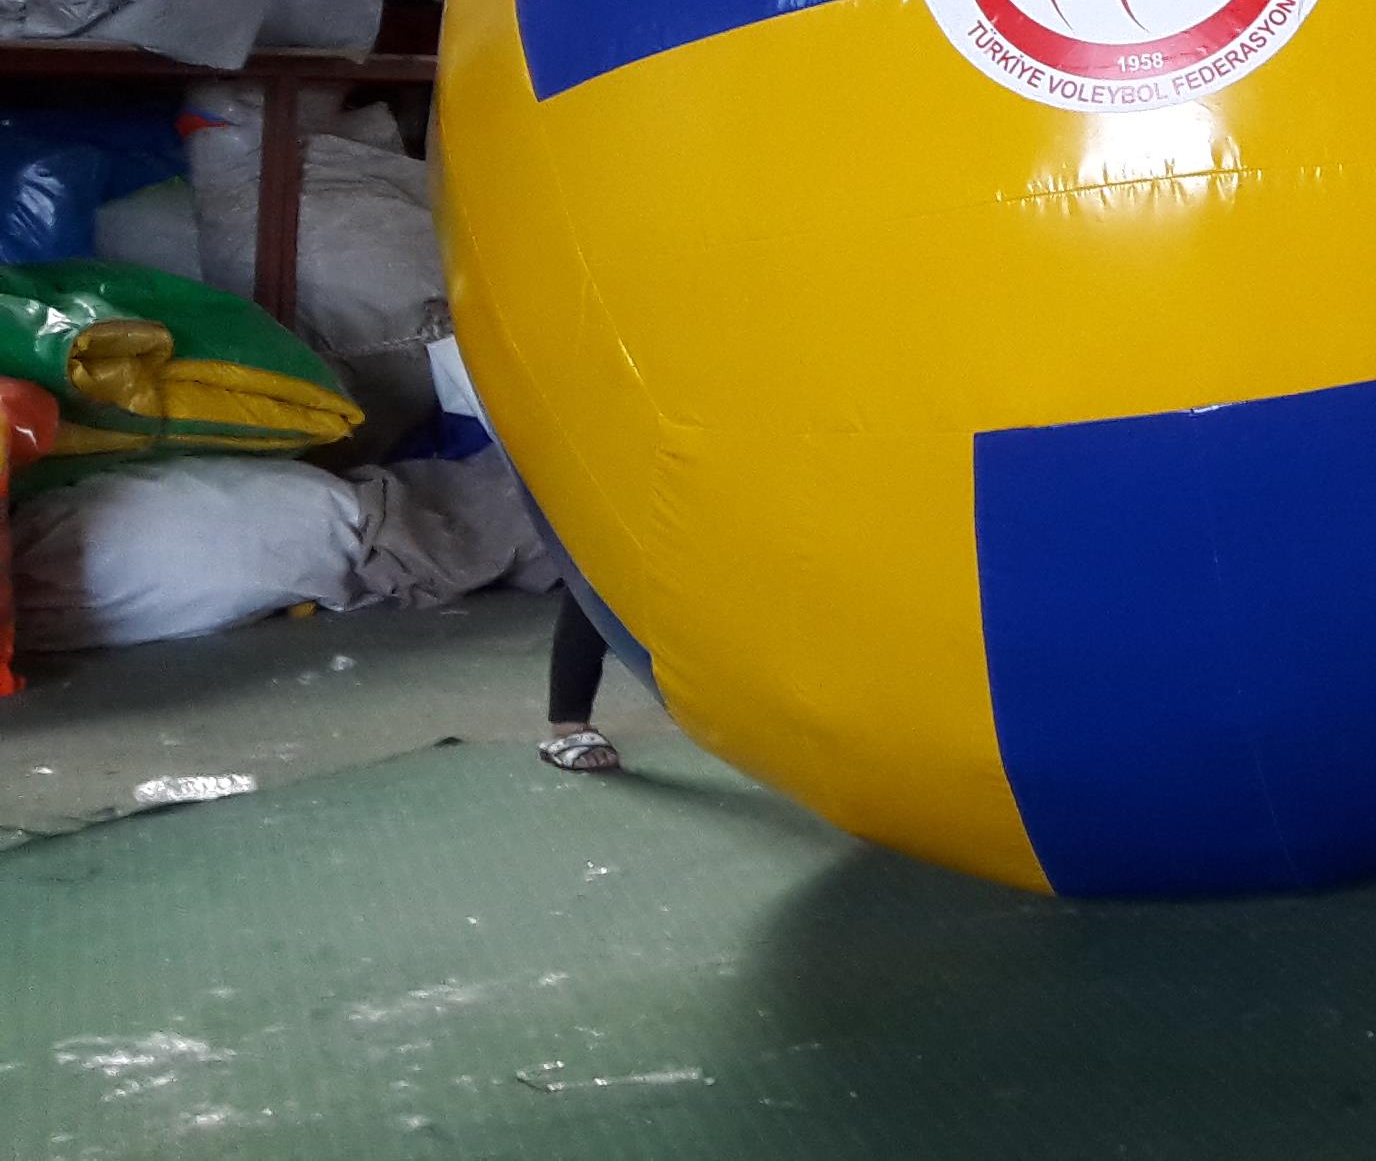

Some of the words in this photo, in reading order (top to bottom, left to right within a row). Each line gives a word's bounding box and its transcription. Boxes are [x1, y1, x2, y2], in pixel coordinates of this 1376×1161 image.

[967, 19, 1045, 88] TÜRKİYE
[1048, 77, 1168, 105] VOLEYBOL
[1116, 52, 1165, 74] 1958
